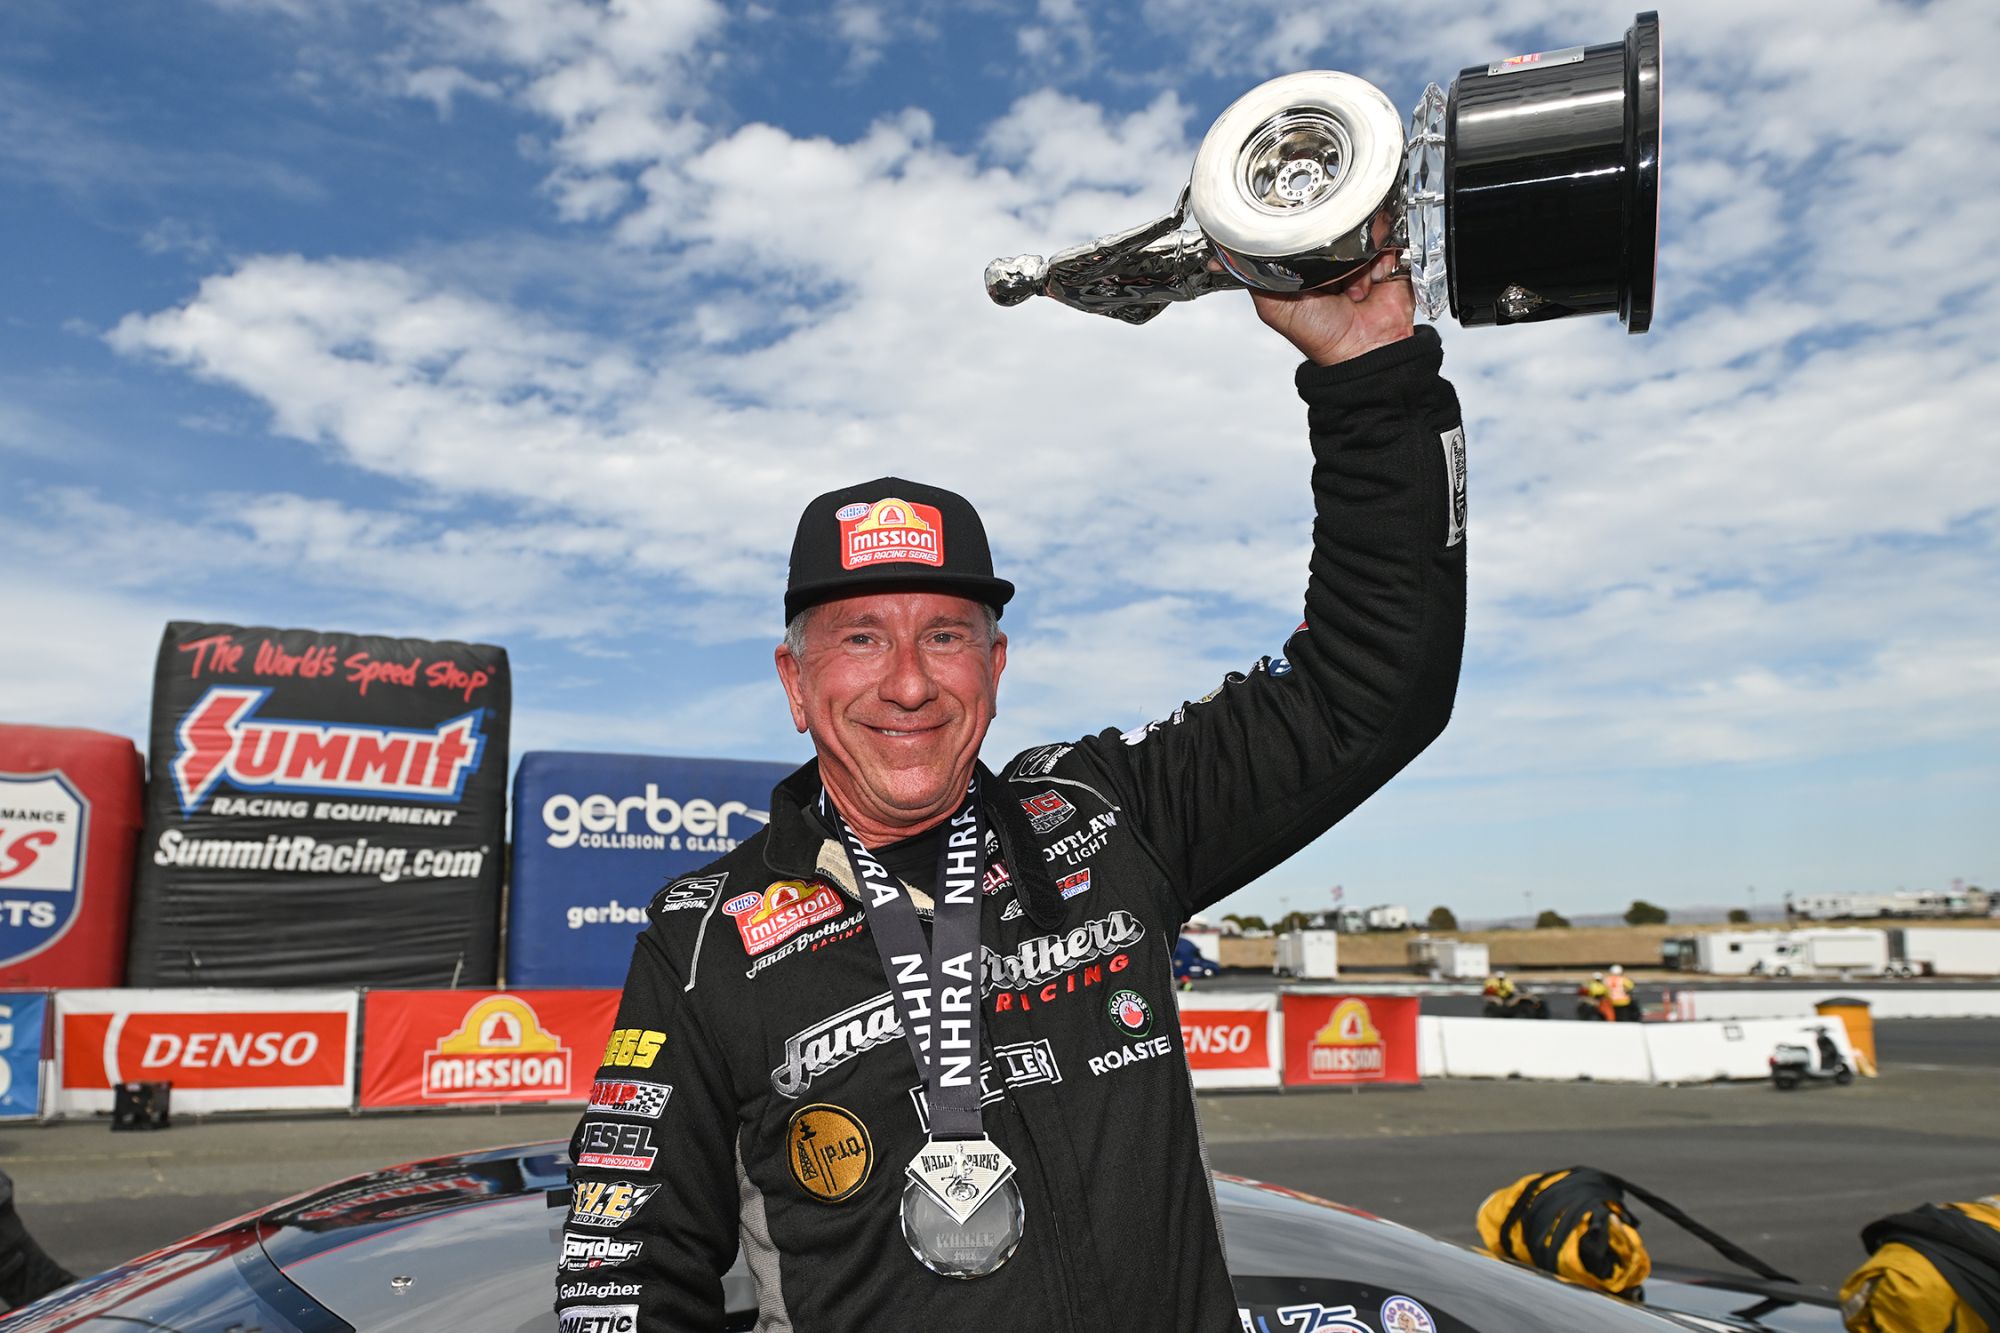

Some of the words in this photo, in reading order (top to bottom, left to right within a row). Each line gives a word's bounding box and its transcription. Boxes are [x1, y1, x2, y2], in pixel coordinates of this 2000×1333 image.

[849, 553, 872, 566] DRAG
[873, 550, 908, 561] RACING
[908, 550, 938, 562] SERIES
[178, 635, 239, 679] The
[253, 639, 335, 678] World's
[344, 651, 421, 696] Speed
[425, 661, 489, 702] Shop
[1042, 745, 1074, 774] SIMPSON
[211, 797, 308, 819] RACING
[314, 801, 457, 826] EQUIPMENT
[542, 783, 748, 849] gerber
[153, 829, 485, 883] SummitRacing.com
[579, 833, 665, 850] COLLISION
[670, 837, 682, 850] &
[945, 805, 977, 904] NHRA
[1066, 832, 1108, 866] LIGHT
[0, 901, 56, 928] TS
[662, 900, 707, 913] SIMPSON
[728, 896, 757, 912] NHRA
[750, 938, 775, 955] DRAG
[776, 920, 809, 944] RACING
[810, 904, 842, 926] SERIES
[1110, 992, 1147, 1015] ROASTERS
[940, 952, 973, 1088] NHRA
[141, 1031, 319, 1068] DENSO
[600, 1029, 668, 1069] EGS
[1088, 1035, 1172, 1076] ROASTE
[966, 1153, 1001, 1172] PARKS
[561, 1282, 642, 1299] Gallagher
